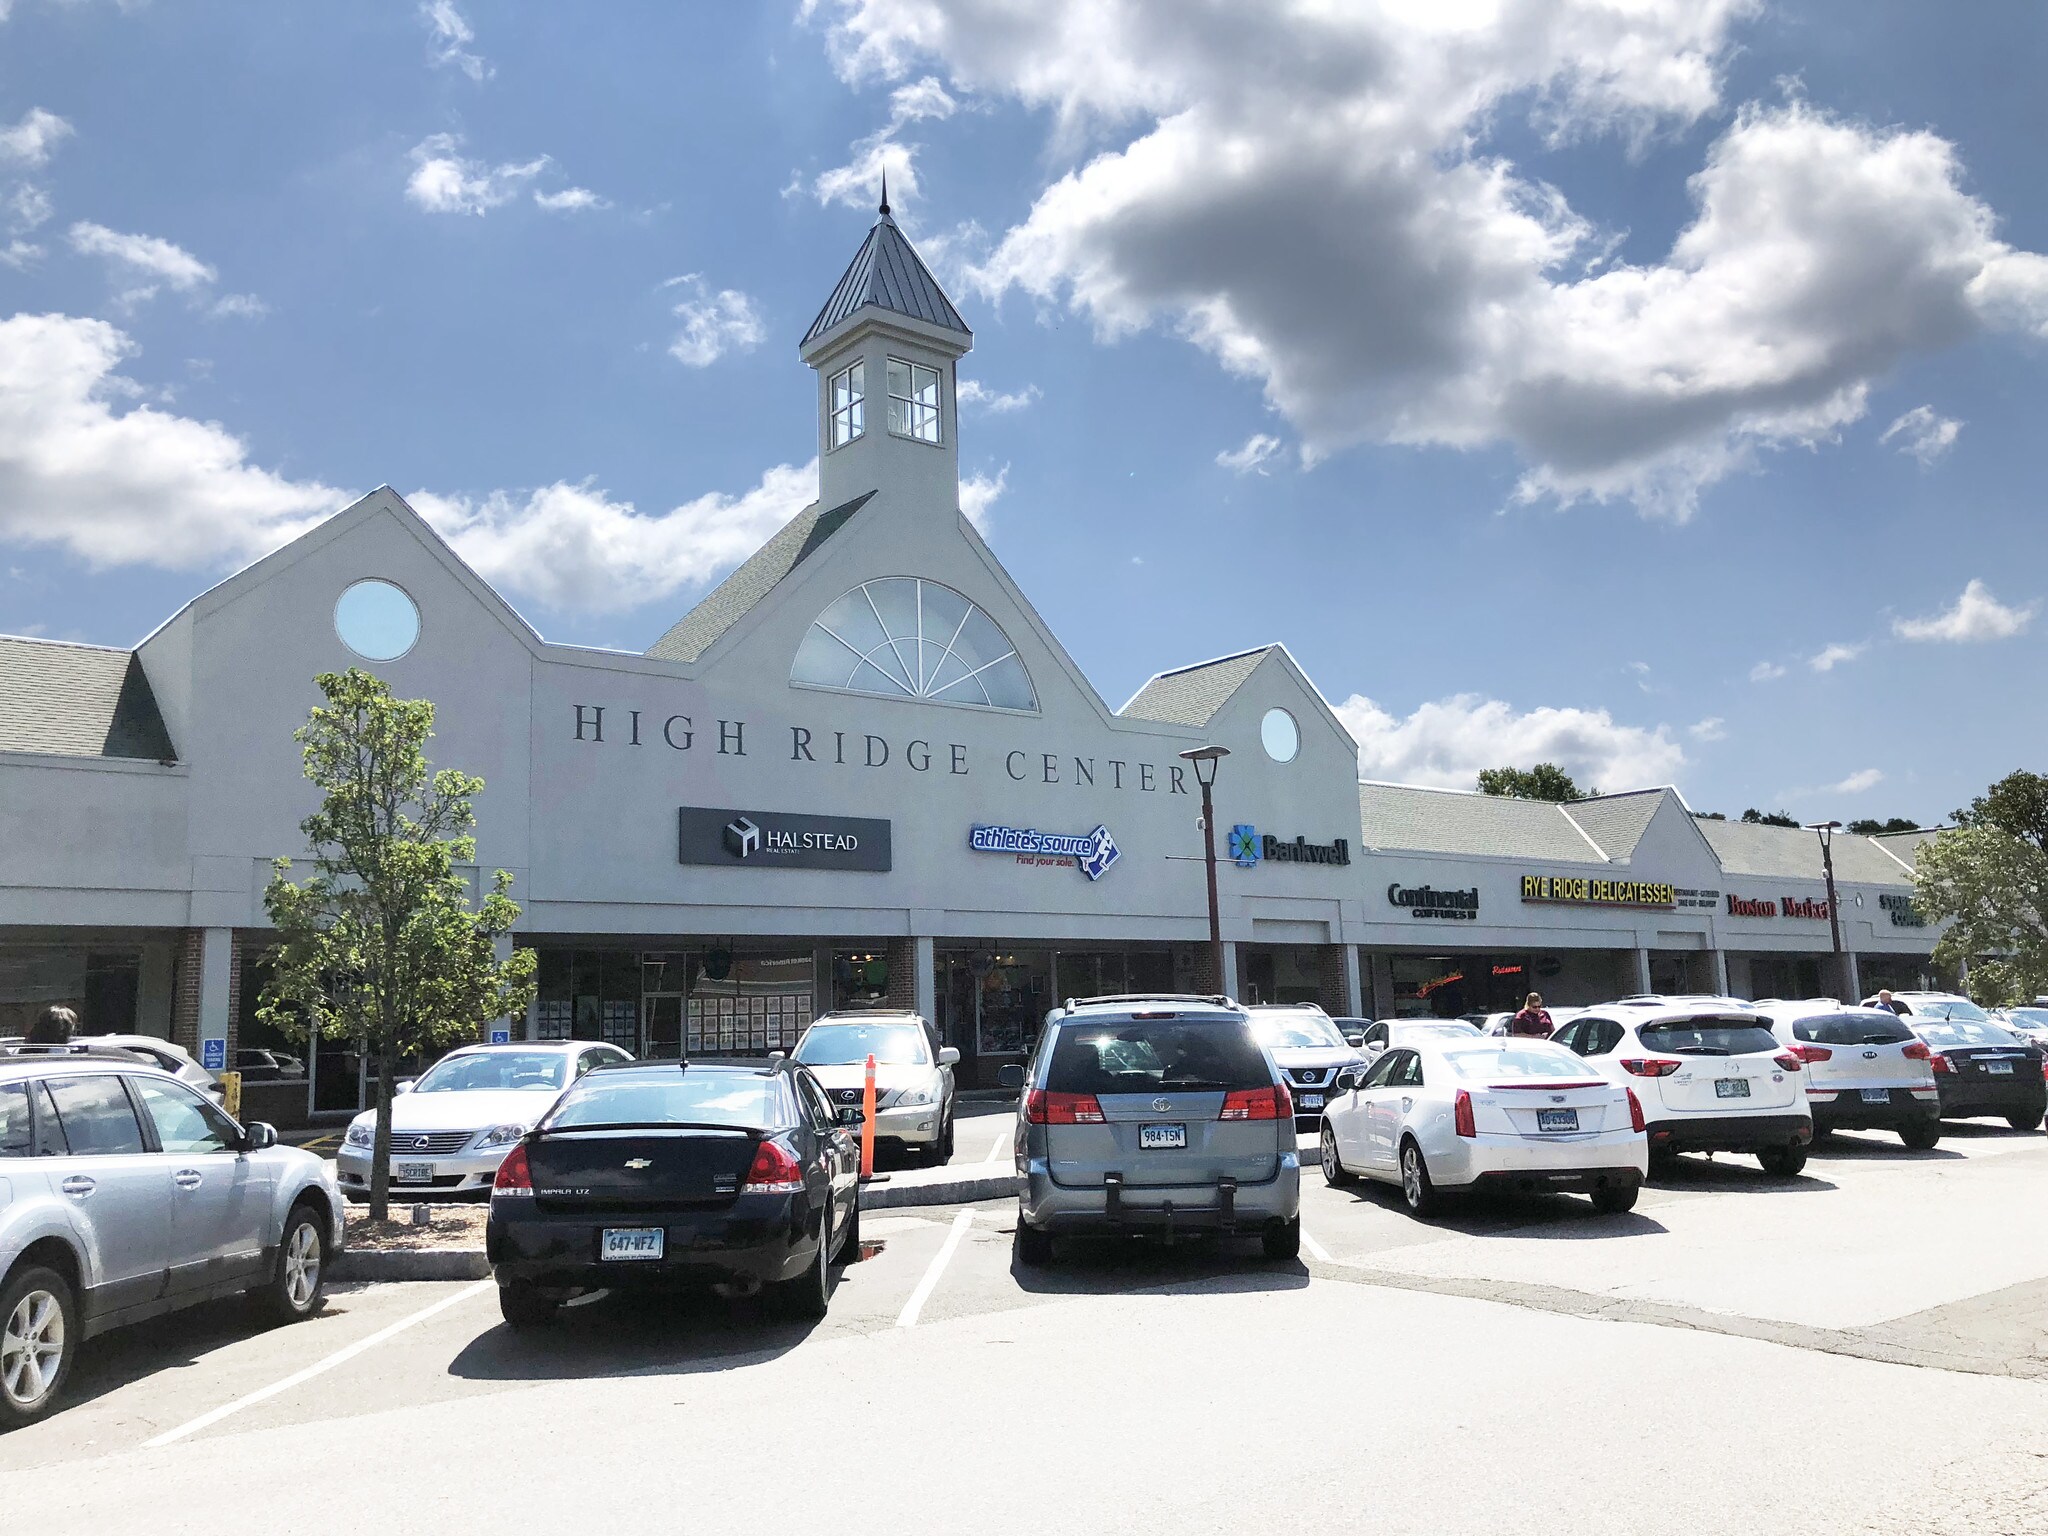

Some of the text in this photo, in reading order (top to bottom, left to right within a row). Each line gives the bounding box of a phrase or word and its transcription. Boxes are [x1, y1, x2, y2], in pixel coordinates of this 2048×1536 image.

[573, 704, 1188, 794] HIGH RIDGE CENTER
[767, 831, 858, 851] HALSTEAD
[974, 827, 1091, 853] athlete's source
[1262, 834, 1350, 865] Bankwell
[1016, 855, 1075, 867] Find your sole.
[1388, 883, 1479, 909] Continental
[1523, 876, 1674, 903] RYE RIDGE DELICATESSEN
[1726, 894, 1777, 916] Boston
